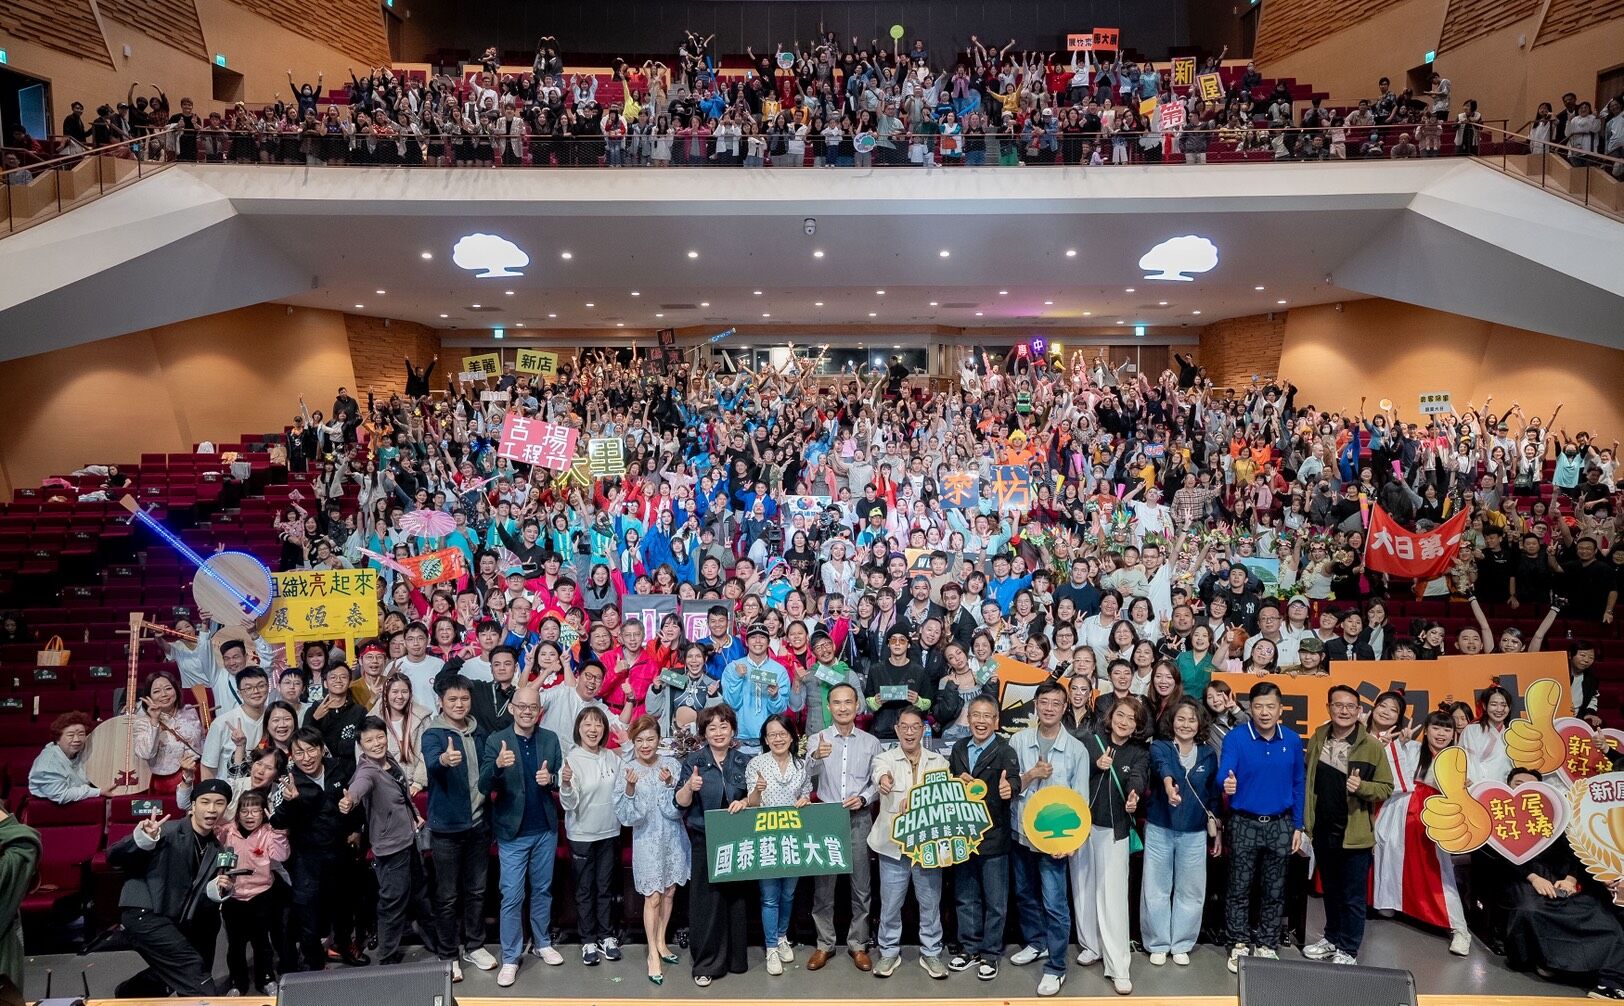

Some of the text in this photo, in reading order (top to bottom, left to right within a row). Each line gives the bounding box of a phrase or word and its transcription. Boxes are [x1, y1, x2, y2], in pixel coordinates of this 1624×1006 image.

[1174, 60, 1194, 85] 新
[1201, 75, 1220, 98] 屋
[521, 353, 552, 372] 新店
[509, 416, 569, 453] 吉揚
[499, 442, 567, 470] 工程行
[924, 772, 948, 784] 2025
[910, 784, 965, 807] GRAND
[1489, 793, 1544, 821] 新屋
[755, 810, 802, 831] 2025
[894, 800, 990, 837] CHAMPION
[1495, 816, 1554, 841] 好棒
[715, 835, 847, 877] 國泰藝能大賞
